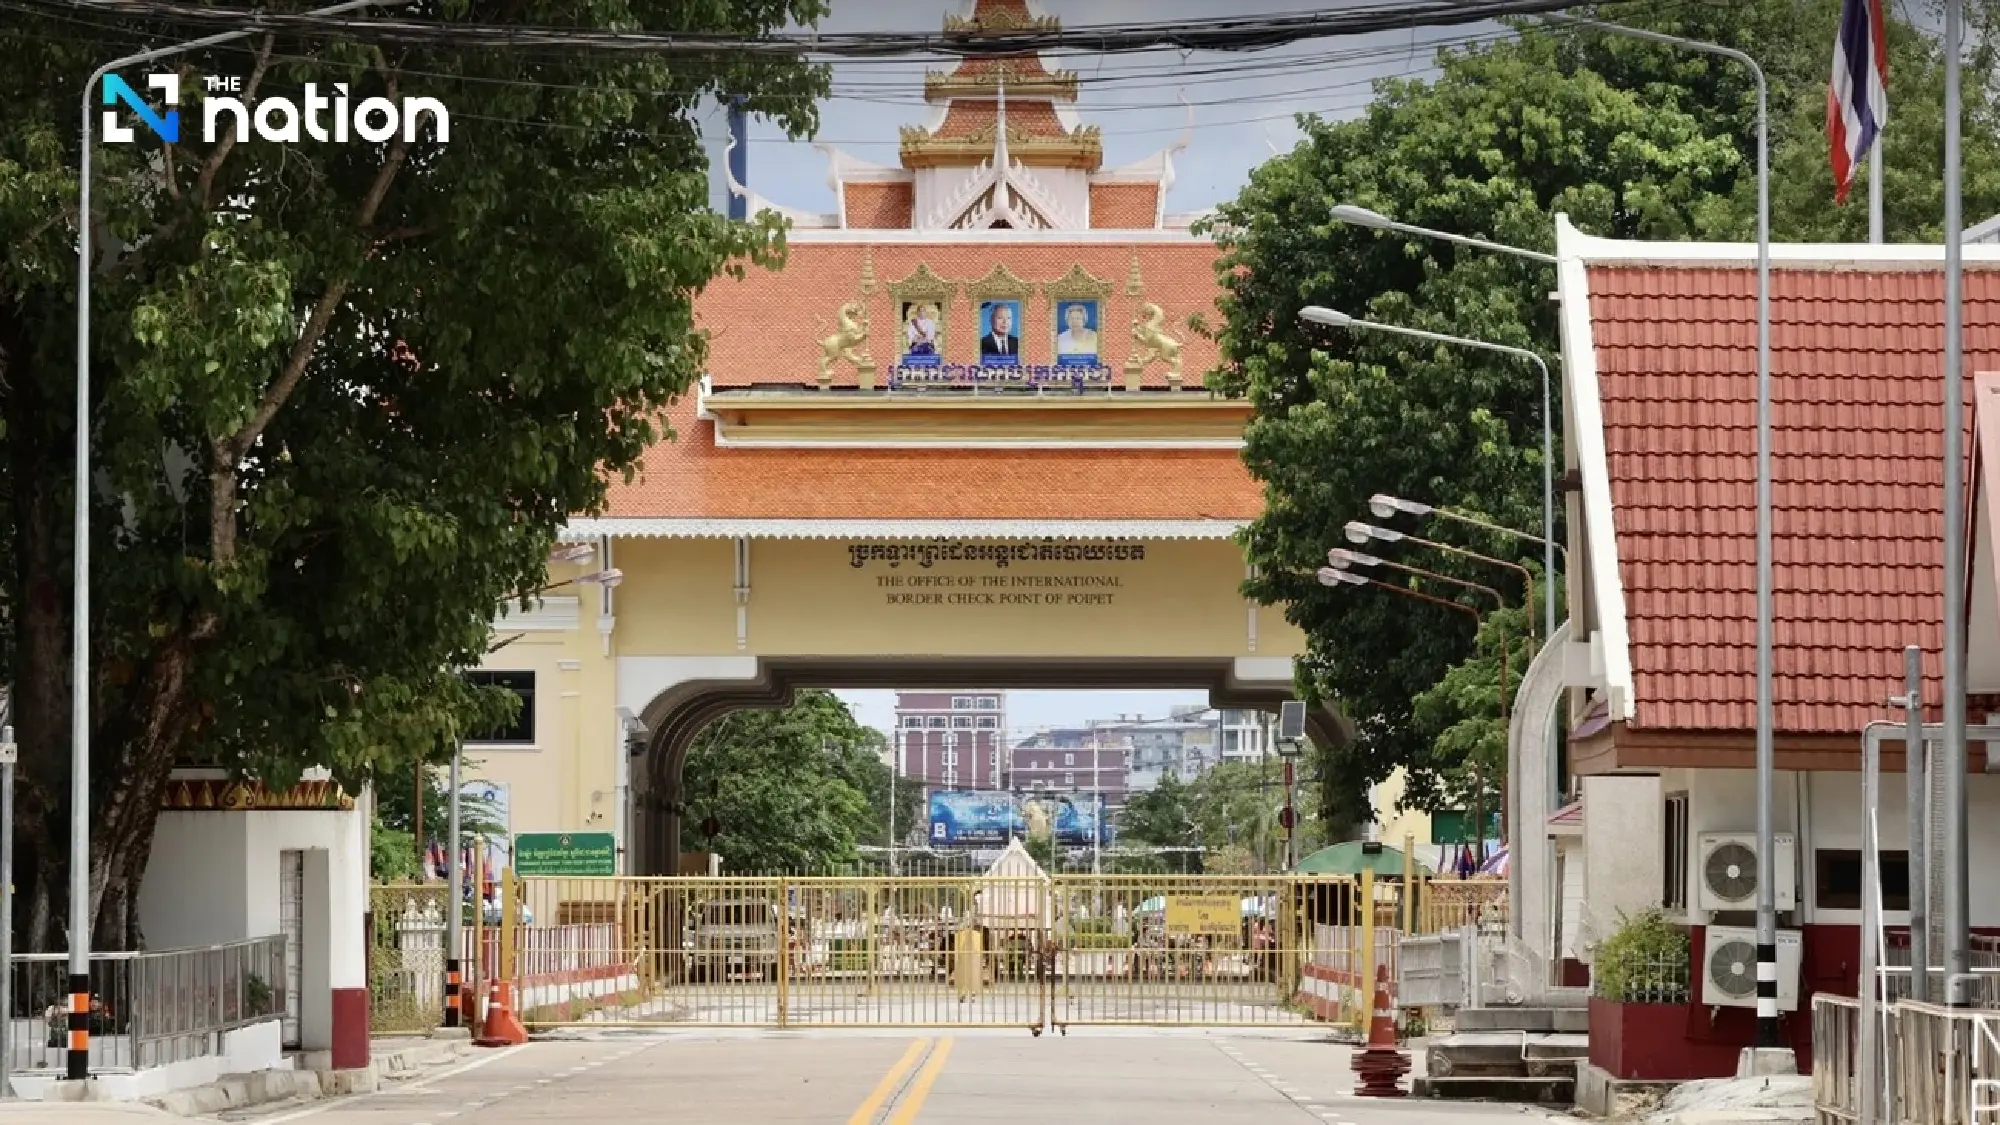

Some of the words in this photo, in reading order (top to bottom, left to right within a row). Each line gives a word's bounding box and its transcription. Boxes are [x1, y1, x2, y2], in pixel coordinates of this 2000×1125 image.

[876, 576, 904, 586] THE
[907, 576, 954, 586] OFFICE
[957, 576, 976, 586] OF
[981, 576, 1008, 586] THE
[1011, 576, 1123, 587] INTERNATIONAL
[887, 593, 943, 604] BORDER
[947, 593, 994, 604] CHECK
[999, 593, 1042, 604] POINT
[1045, 593, 1063, 604] OF
[1067, 593, 1115, 604] POIPET
